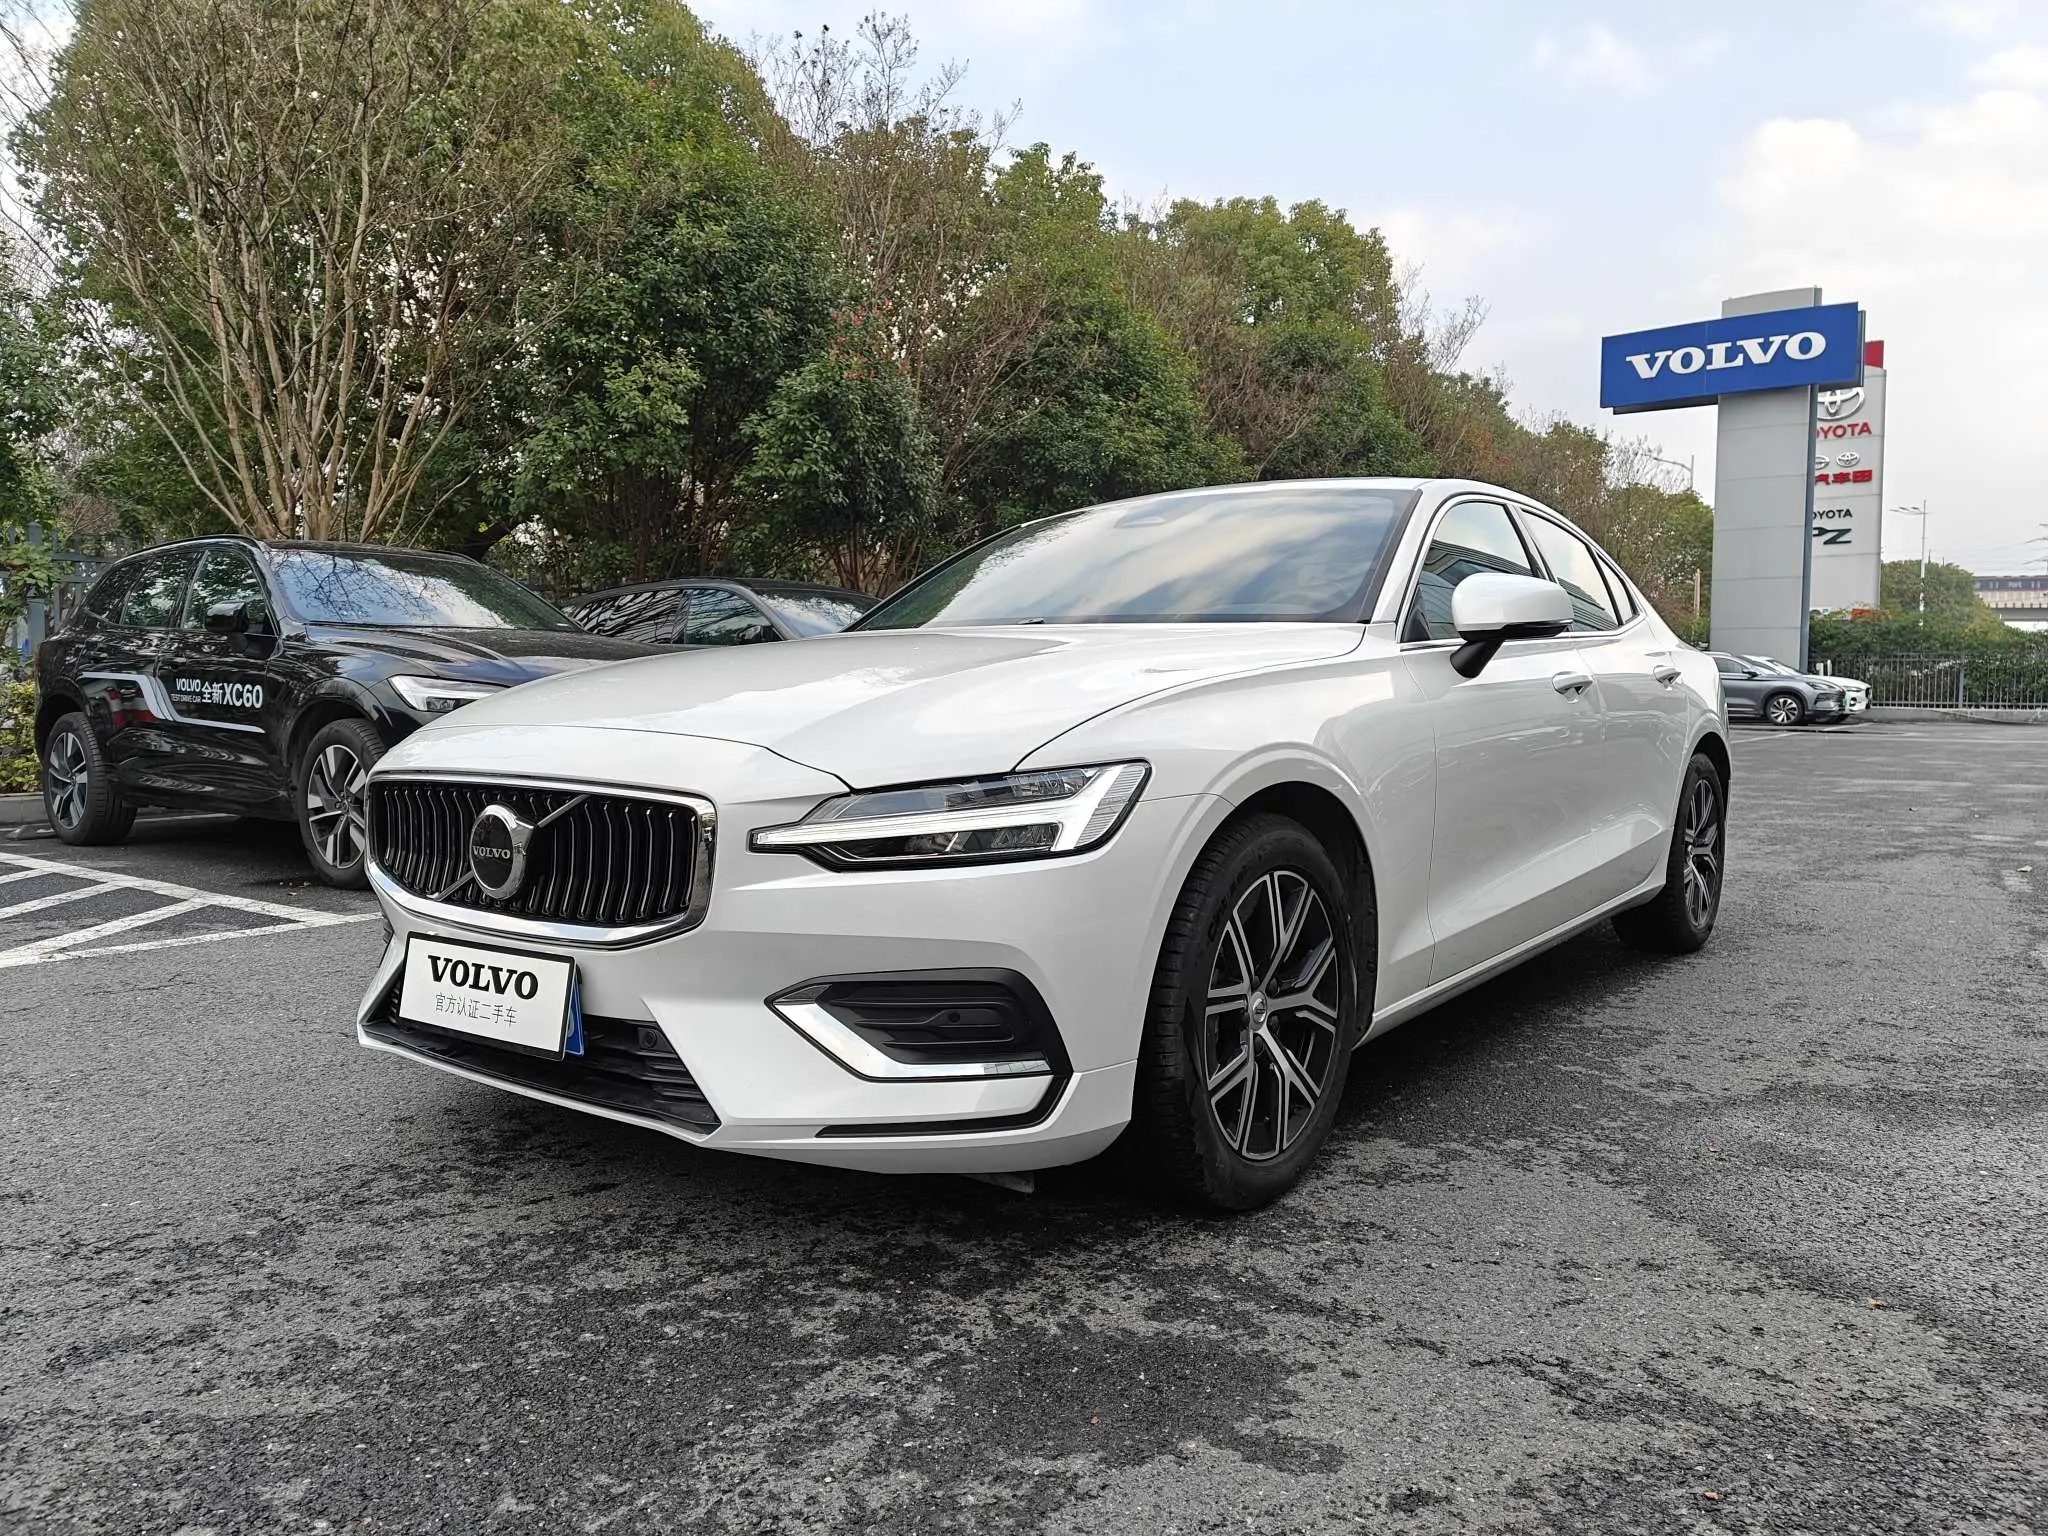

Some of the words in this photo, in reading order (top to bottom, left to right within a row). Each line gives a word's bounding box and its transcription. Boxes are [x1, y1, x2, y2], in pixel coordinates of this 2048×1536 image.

[1626, 332, 1826, 379] VOLVO
[176, 678, 201, 692] VOLVO
[472, 845, 511, 859] VOLVO
[428, 954, 539, 1000] VOLVO
[434, 993, 518, 1028] 官方认证二手车
